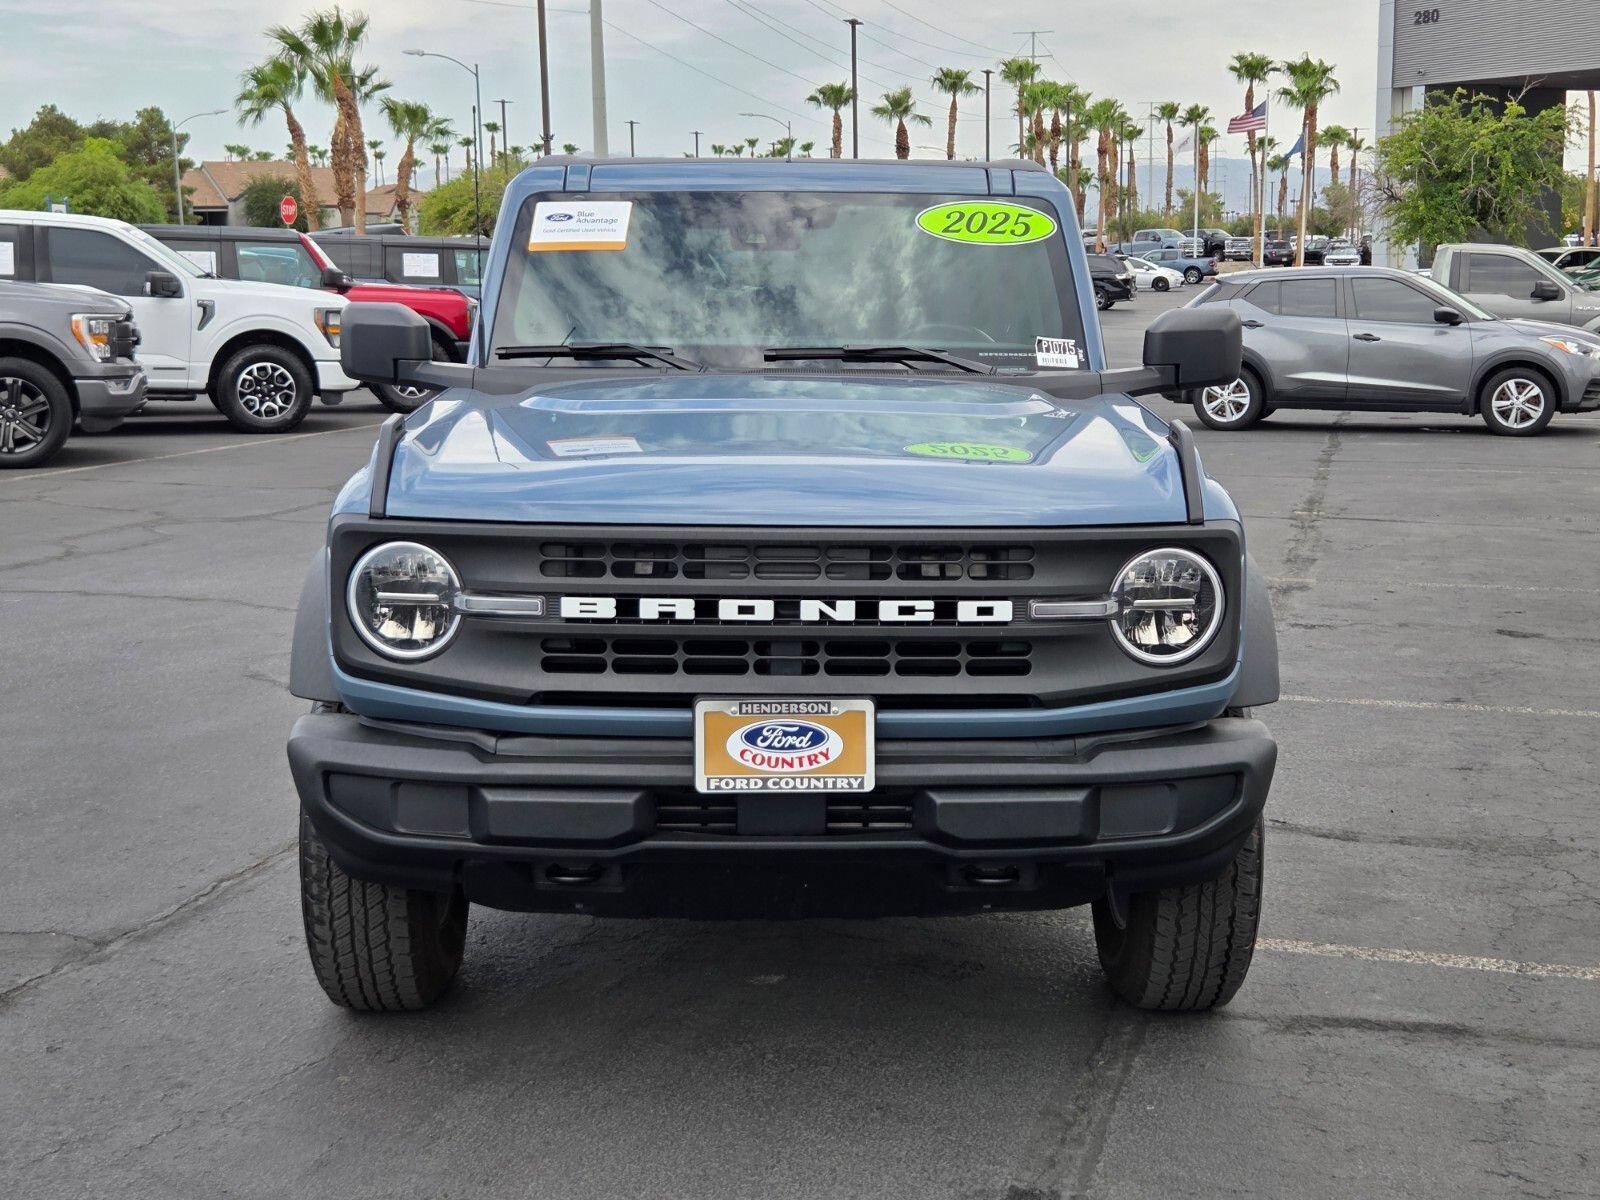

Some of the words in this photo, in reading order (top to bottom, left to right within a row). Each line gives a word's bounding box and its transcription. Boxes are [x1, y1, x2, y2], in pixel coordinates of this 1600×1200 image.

[1414, 9, 1440, 25] 280
[282, 204, 296, 215] STOP
[576, 217, 619, 225] Advantage
[941, 210, 1033, 237] 2025
[1042, 340, 1076, 355] P10715
[560, 596, 1013, 621] BRONCO
[741, 703, 829, 714] HENDERSON
[756, 725, 814, 748] Ford
[739, 747, 831, 769] COUNTRY
[709, 777, 763, 790] FORD
[767, 777, 863, 790] COUNTRY
